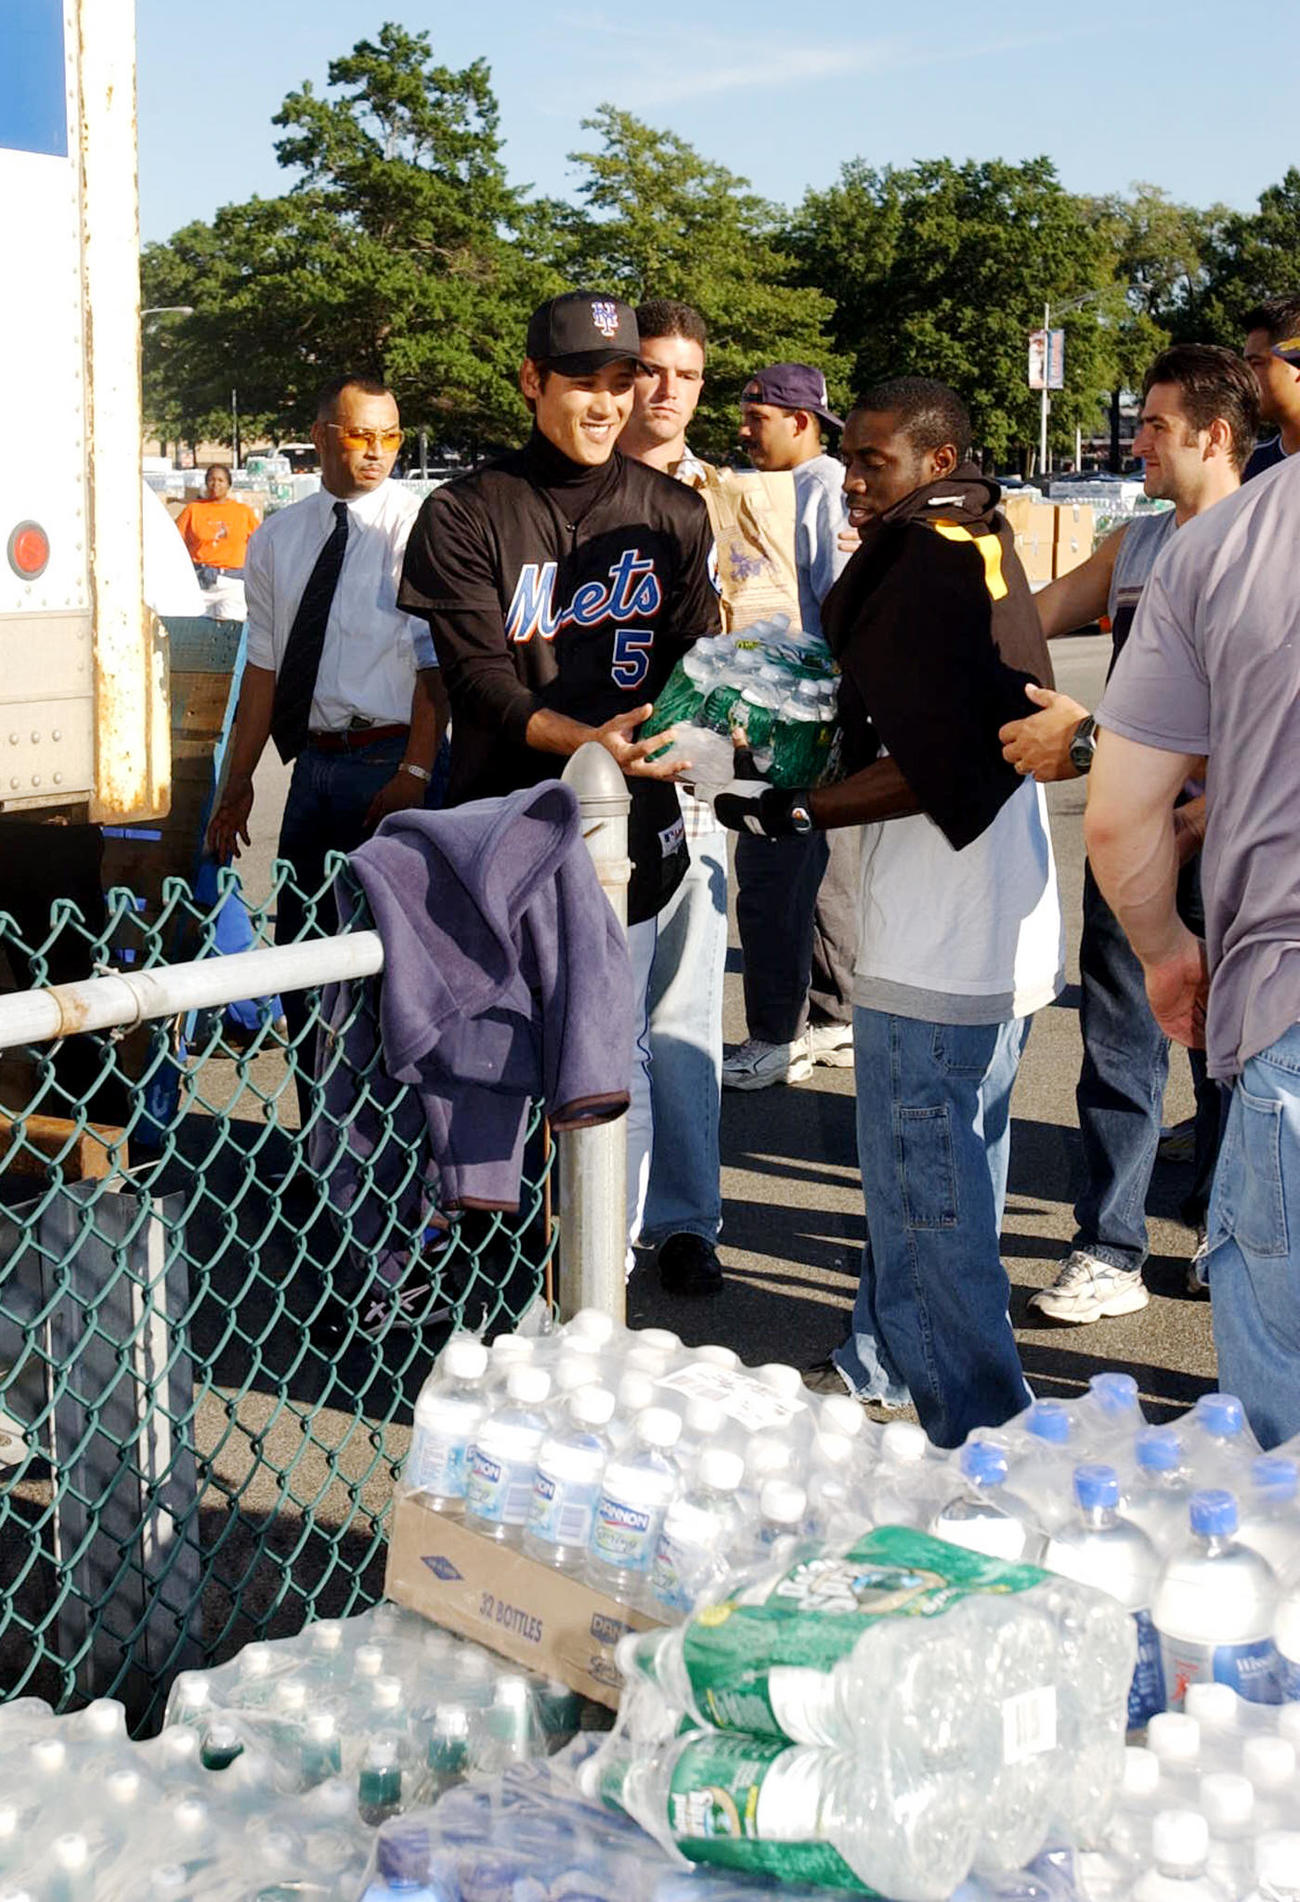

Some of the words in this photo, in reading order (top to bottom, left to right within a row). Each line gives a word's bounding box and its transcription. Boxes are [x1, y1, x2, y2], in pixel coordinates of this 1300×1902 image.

[506, 549, 661, 642] Mets
[611, 628, 654, 690] 5
[480, 1592, 495, 1619] 32
[496, 1600, 543, 1643] BOTTLES
